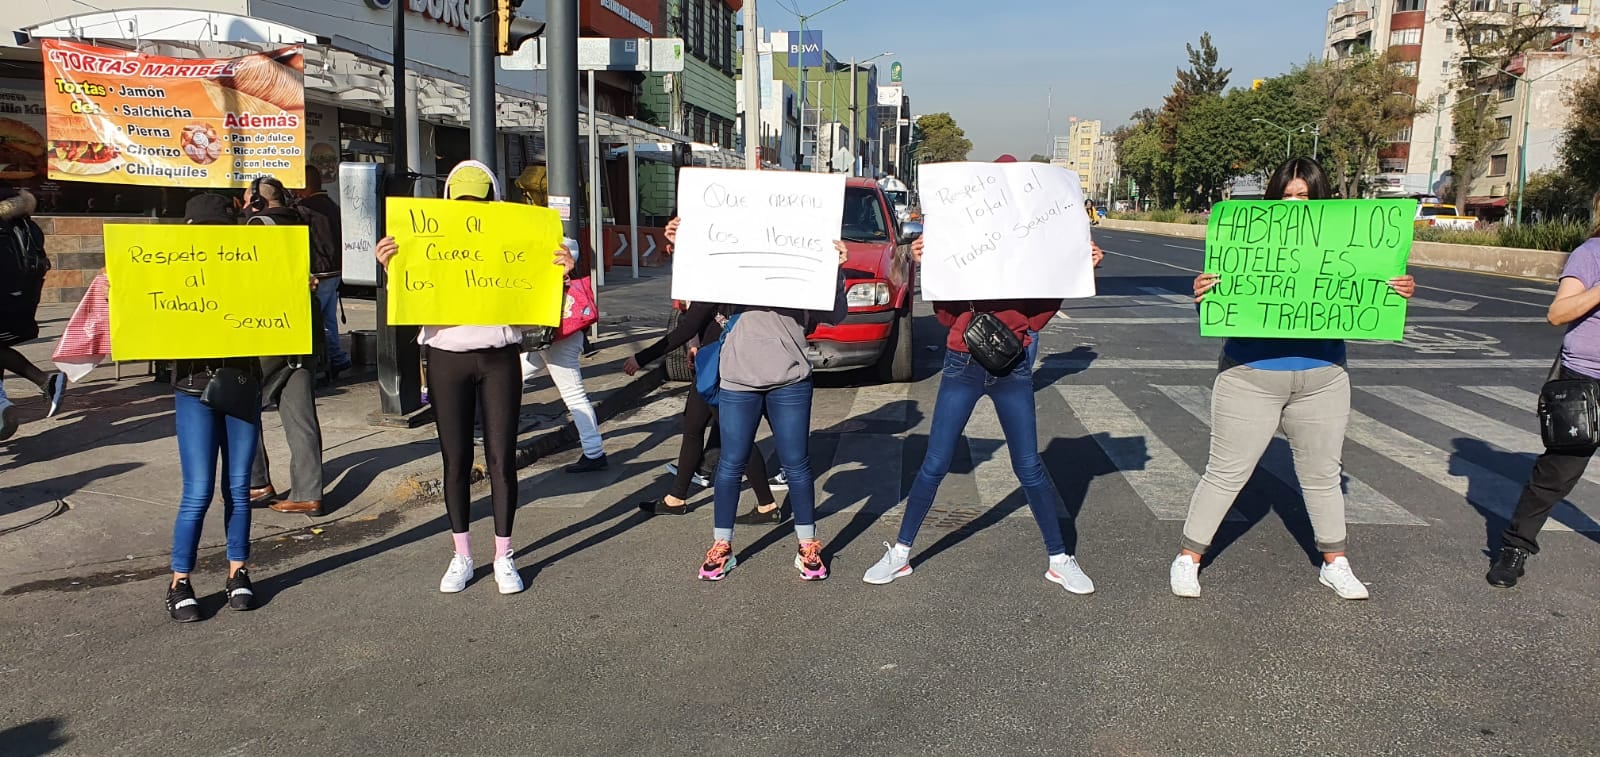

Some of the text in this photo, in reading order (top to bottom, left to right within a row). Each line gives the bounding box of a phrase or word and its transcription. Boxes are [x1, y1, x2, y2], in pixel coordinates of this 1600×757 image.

[791, 43, 819, 53] BBVA
[51, 52, 138, 74] “TORTAS
[55, 79, 106, 96] Tortas
[119, 85, 165, 98] Jamón
[123, 105, 192, 118] Salchicha
[224, 113, 297, 127] Además
[127, 124, 170, 138] Pierna
[232, 134, 294, 142] Pan de dulce
[127, 144, 181, 157] Chorizo
[234, 147, 255, 155] Rico
[280, 147, 300, 155] solo
[126, 163, 208, 178] Chilaquiles
[262, 160, 290, 168] leche
[1023, 168, 1043, 193] al
[935, 175, 996, 205] Respeto
[1216, 204, 1402, 248] HABRAN LOS
[128, 244, 258, 265] Respeto total
[943, 231, 1002, 269] Trabajo
[1208, 245, 1357, 278] HOTELES ES
[185, 268, 205, 288] al
[1312, 277, 1400, 307] FUENTE
[147, 291, 218, 313] Trabajo
[223, 312, 291, 329] Sexual
[1205, 300, 1380, 332] DE TRABAJO
